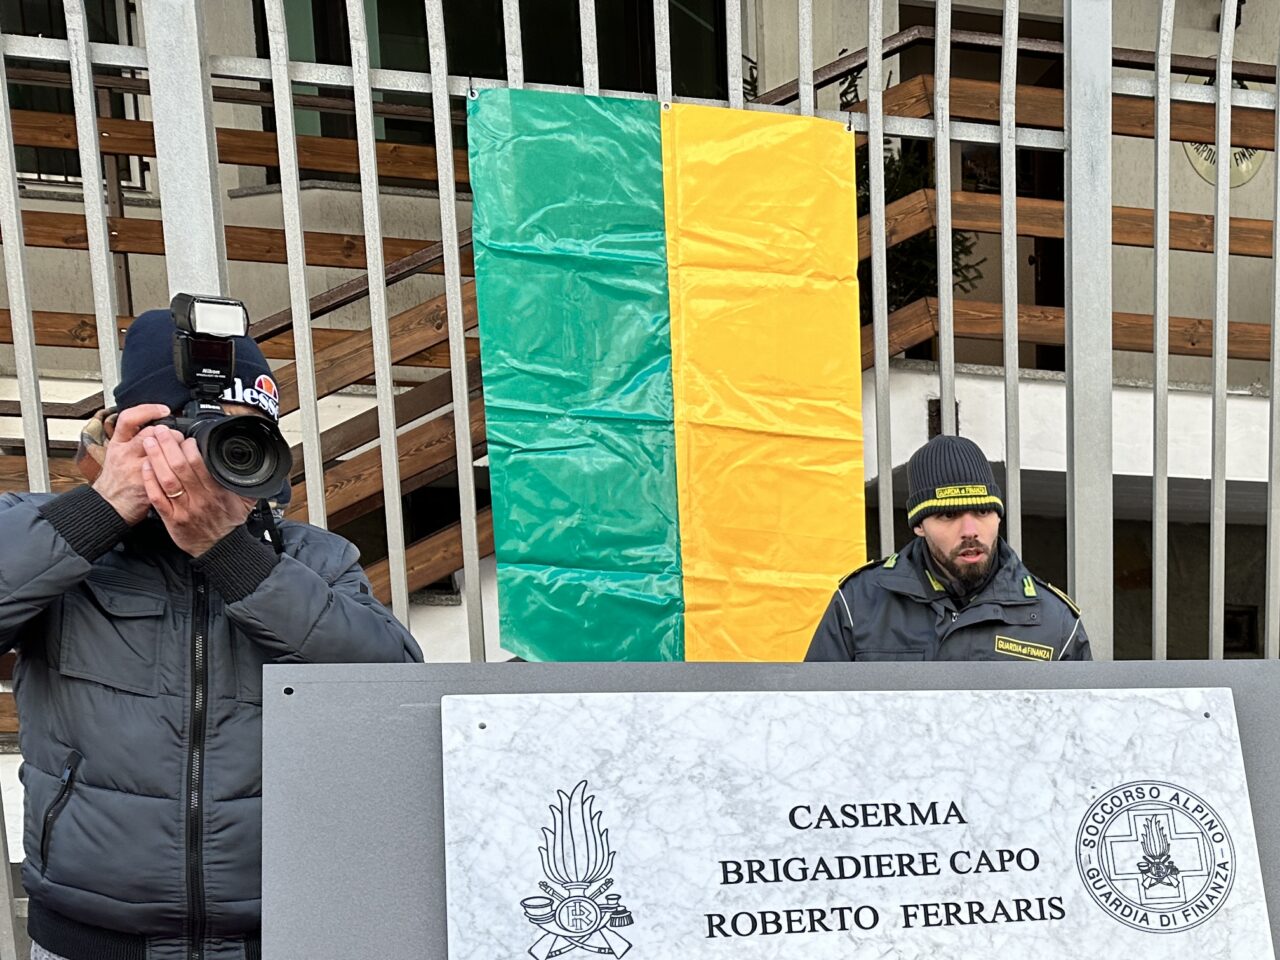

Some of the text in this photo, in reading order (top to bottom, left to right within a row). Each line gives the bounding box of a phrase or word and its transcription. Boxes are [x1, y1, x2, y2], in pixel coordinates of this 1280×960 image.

[998, 639, 1022, 652] GUARDIA
[1027, 646, 1050, 659] FINANZA
[788, 800, 968, 830] CASERMA
[1082, 786, 1225, 849] SOCCORSO ALPINO
[718, 847, 1040, 885] BRIGADIERE CAPO
[1086, 860, 1230, 927] GUARDIA DI FINANZA
[704, 896, 1066, 939] ROBERTO FERRARIS
